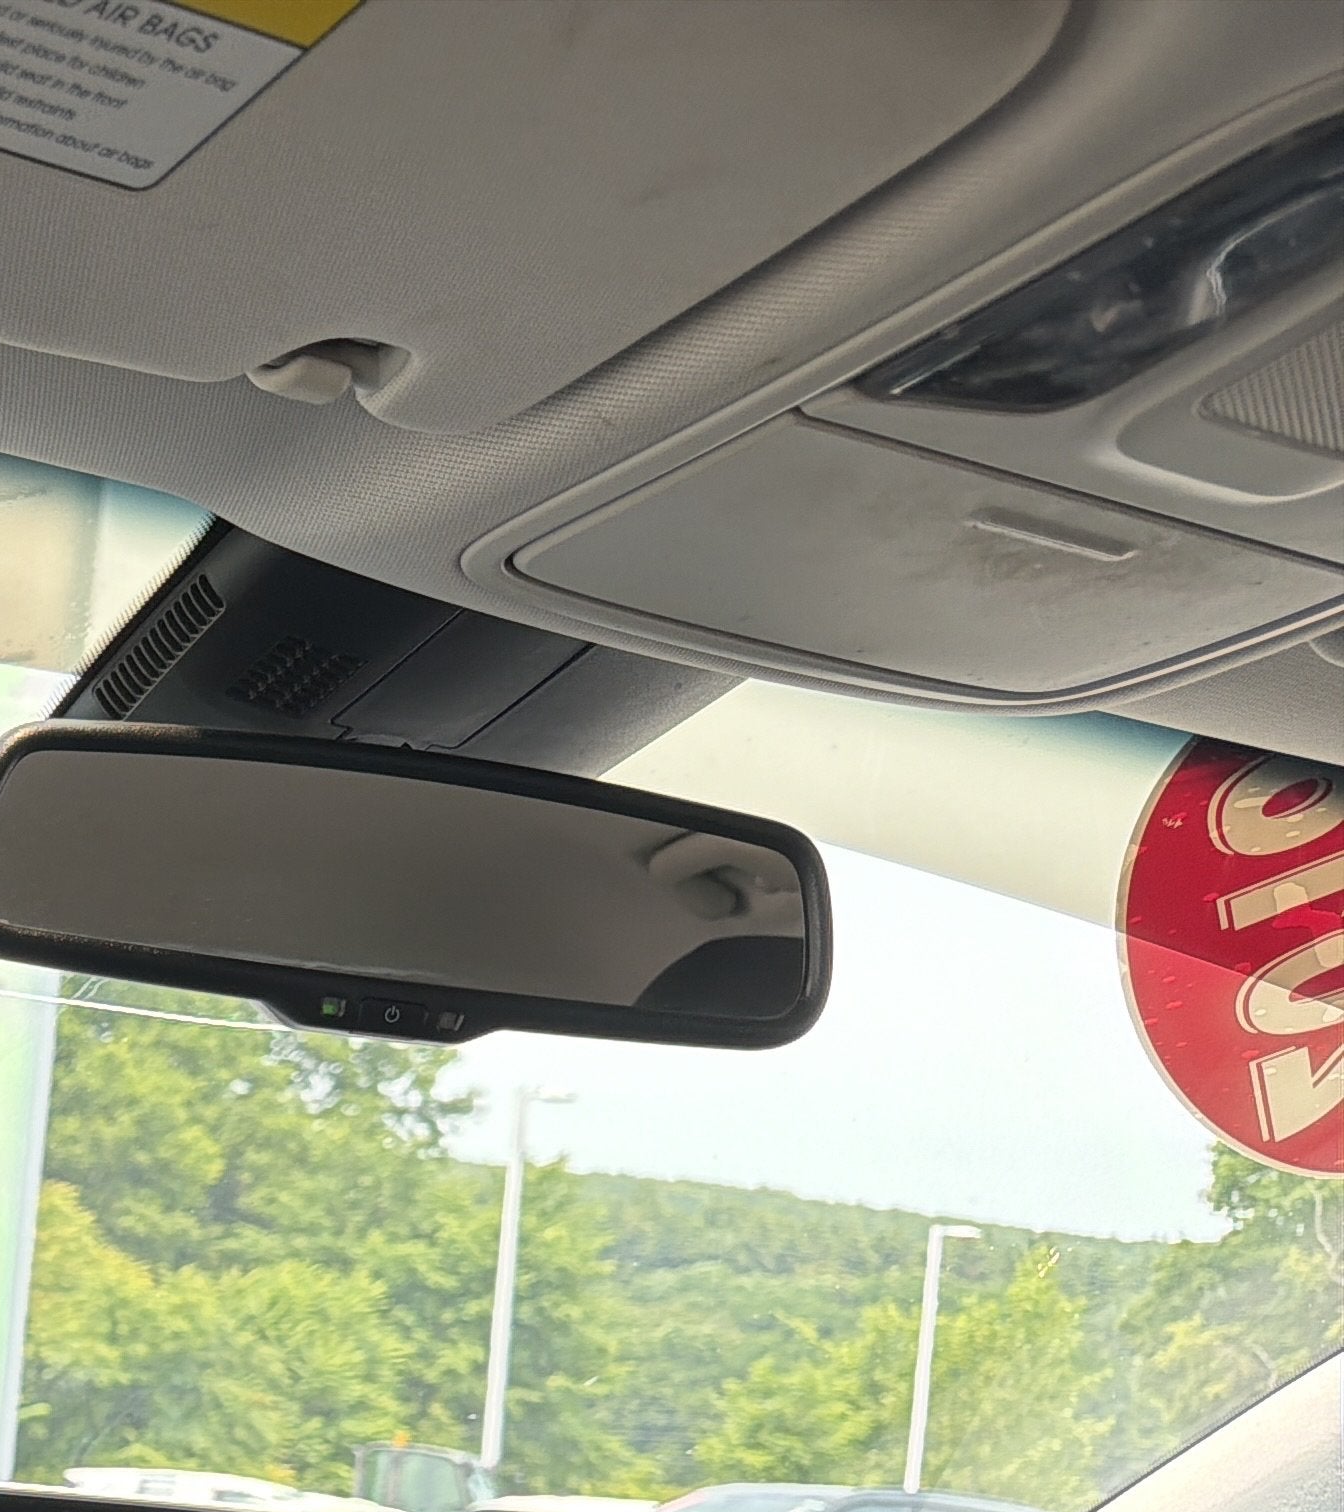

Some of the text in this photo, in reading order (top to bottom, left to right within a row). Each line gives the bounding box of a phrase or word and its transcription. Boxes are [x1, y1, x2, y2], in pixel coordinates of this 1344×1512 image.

[84, 0, 219, 53] AIR BAGS
[67, 83, 92, 99] the
[160, 57, 184, 73] the
[205, 73, 237, 92] bag
[55, 133, 100, 153] about
[117, 151, 157, 170] bags
